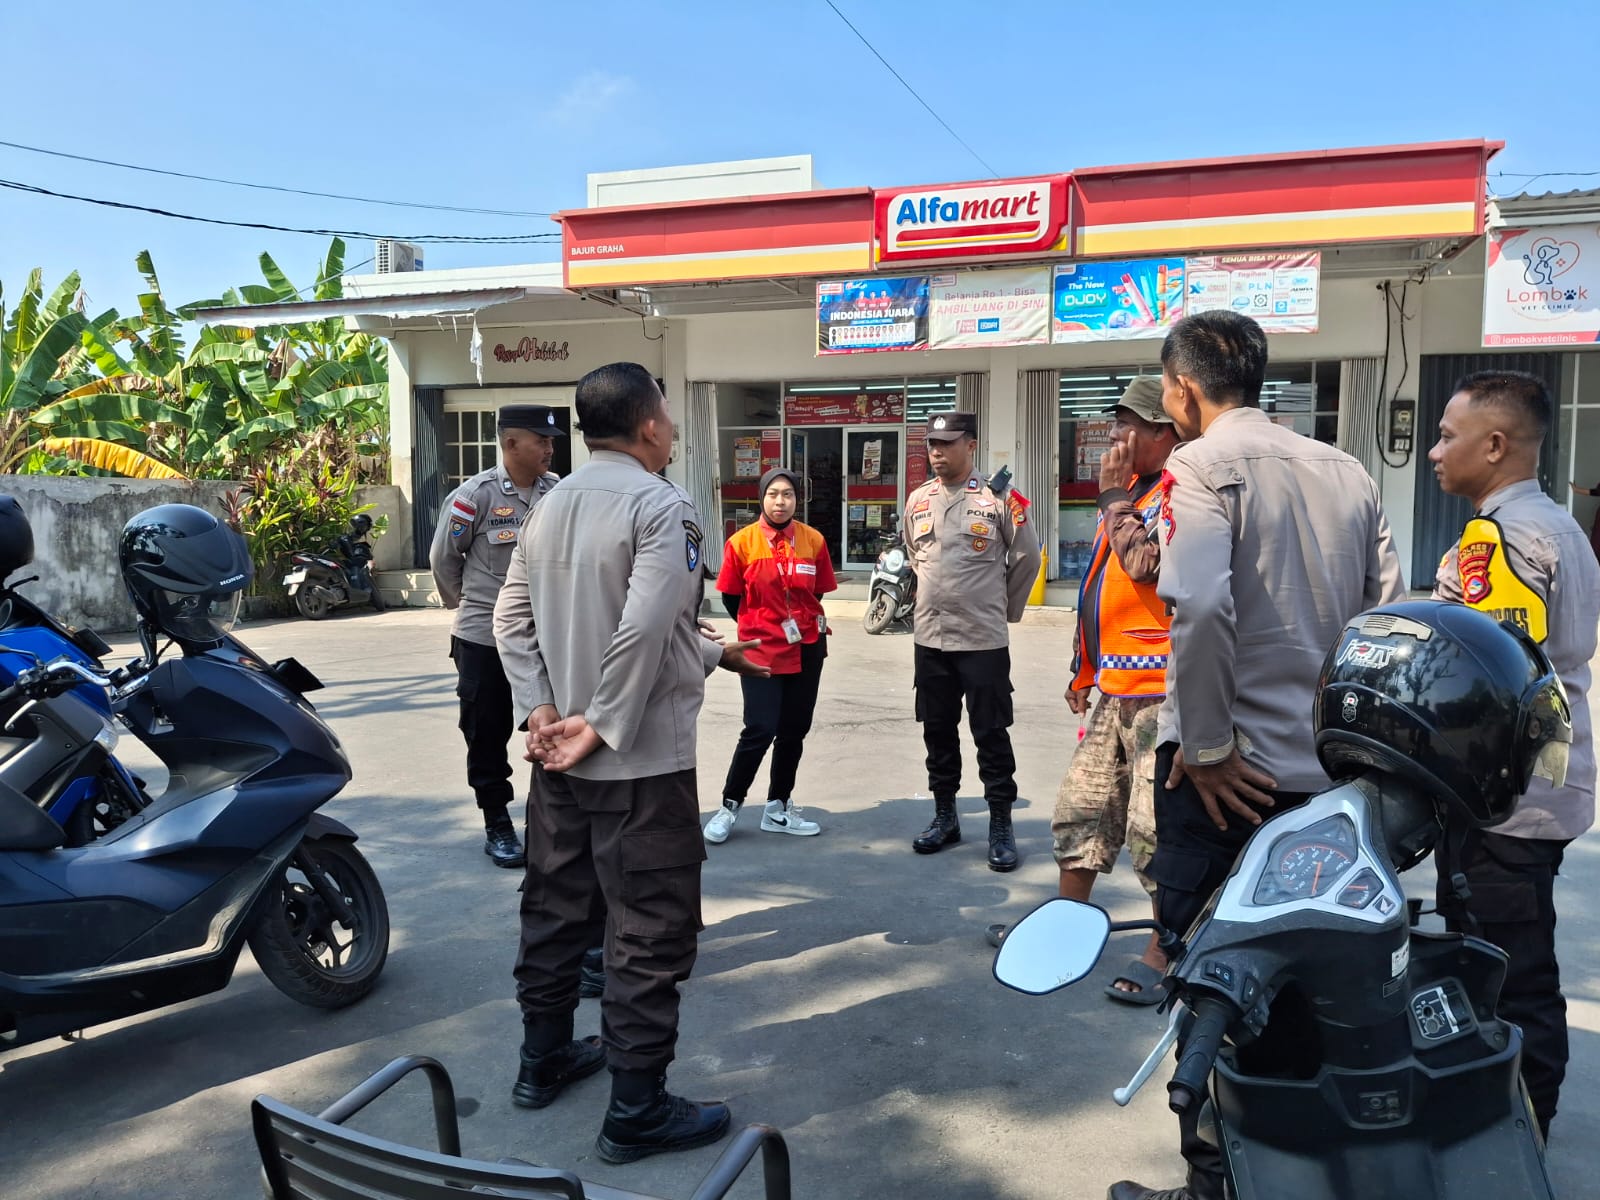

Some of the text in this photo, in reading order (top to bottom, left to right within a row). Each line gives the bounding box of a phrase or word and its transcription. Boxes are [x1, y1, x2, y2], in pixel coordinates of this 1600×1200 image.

[896, 190, 1041, 226] Alfamart
[571, 244, 625, 256] BAJUR GRAHA
[1221, 256, 1247, 264] SEMUA
[1068, 282, 1083, 290] The
[1248, 282, 1273, 291] PLN
[944, 292, 981, 301] Belanja
[982, 290, 996, 300] Rp
[1014, 288, 1036, 297] Bisa
[937, 299, 1045, 314] AMBIL UANG DI SINI
[830, 307, 915, 321] INDONESIA JUARA
[1502, 335, 1578, 344] lombokvetclinic
[966, 509, 996, 520] POLRI
[219, 574, 245, 586] HONDA
